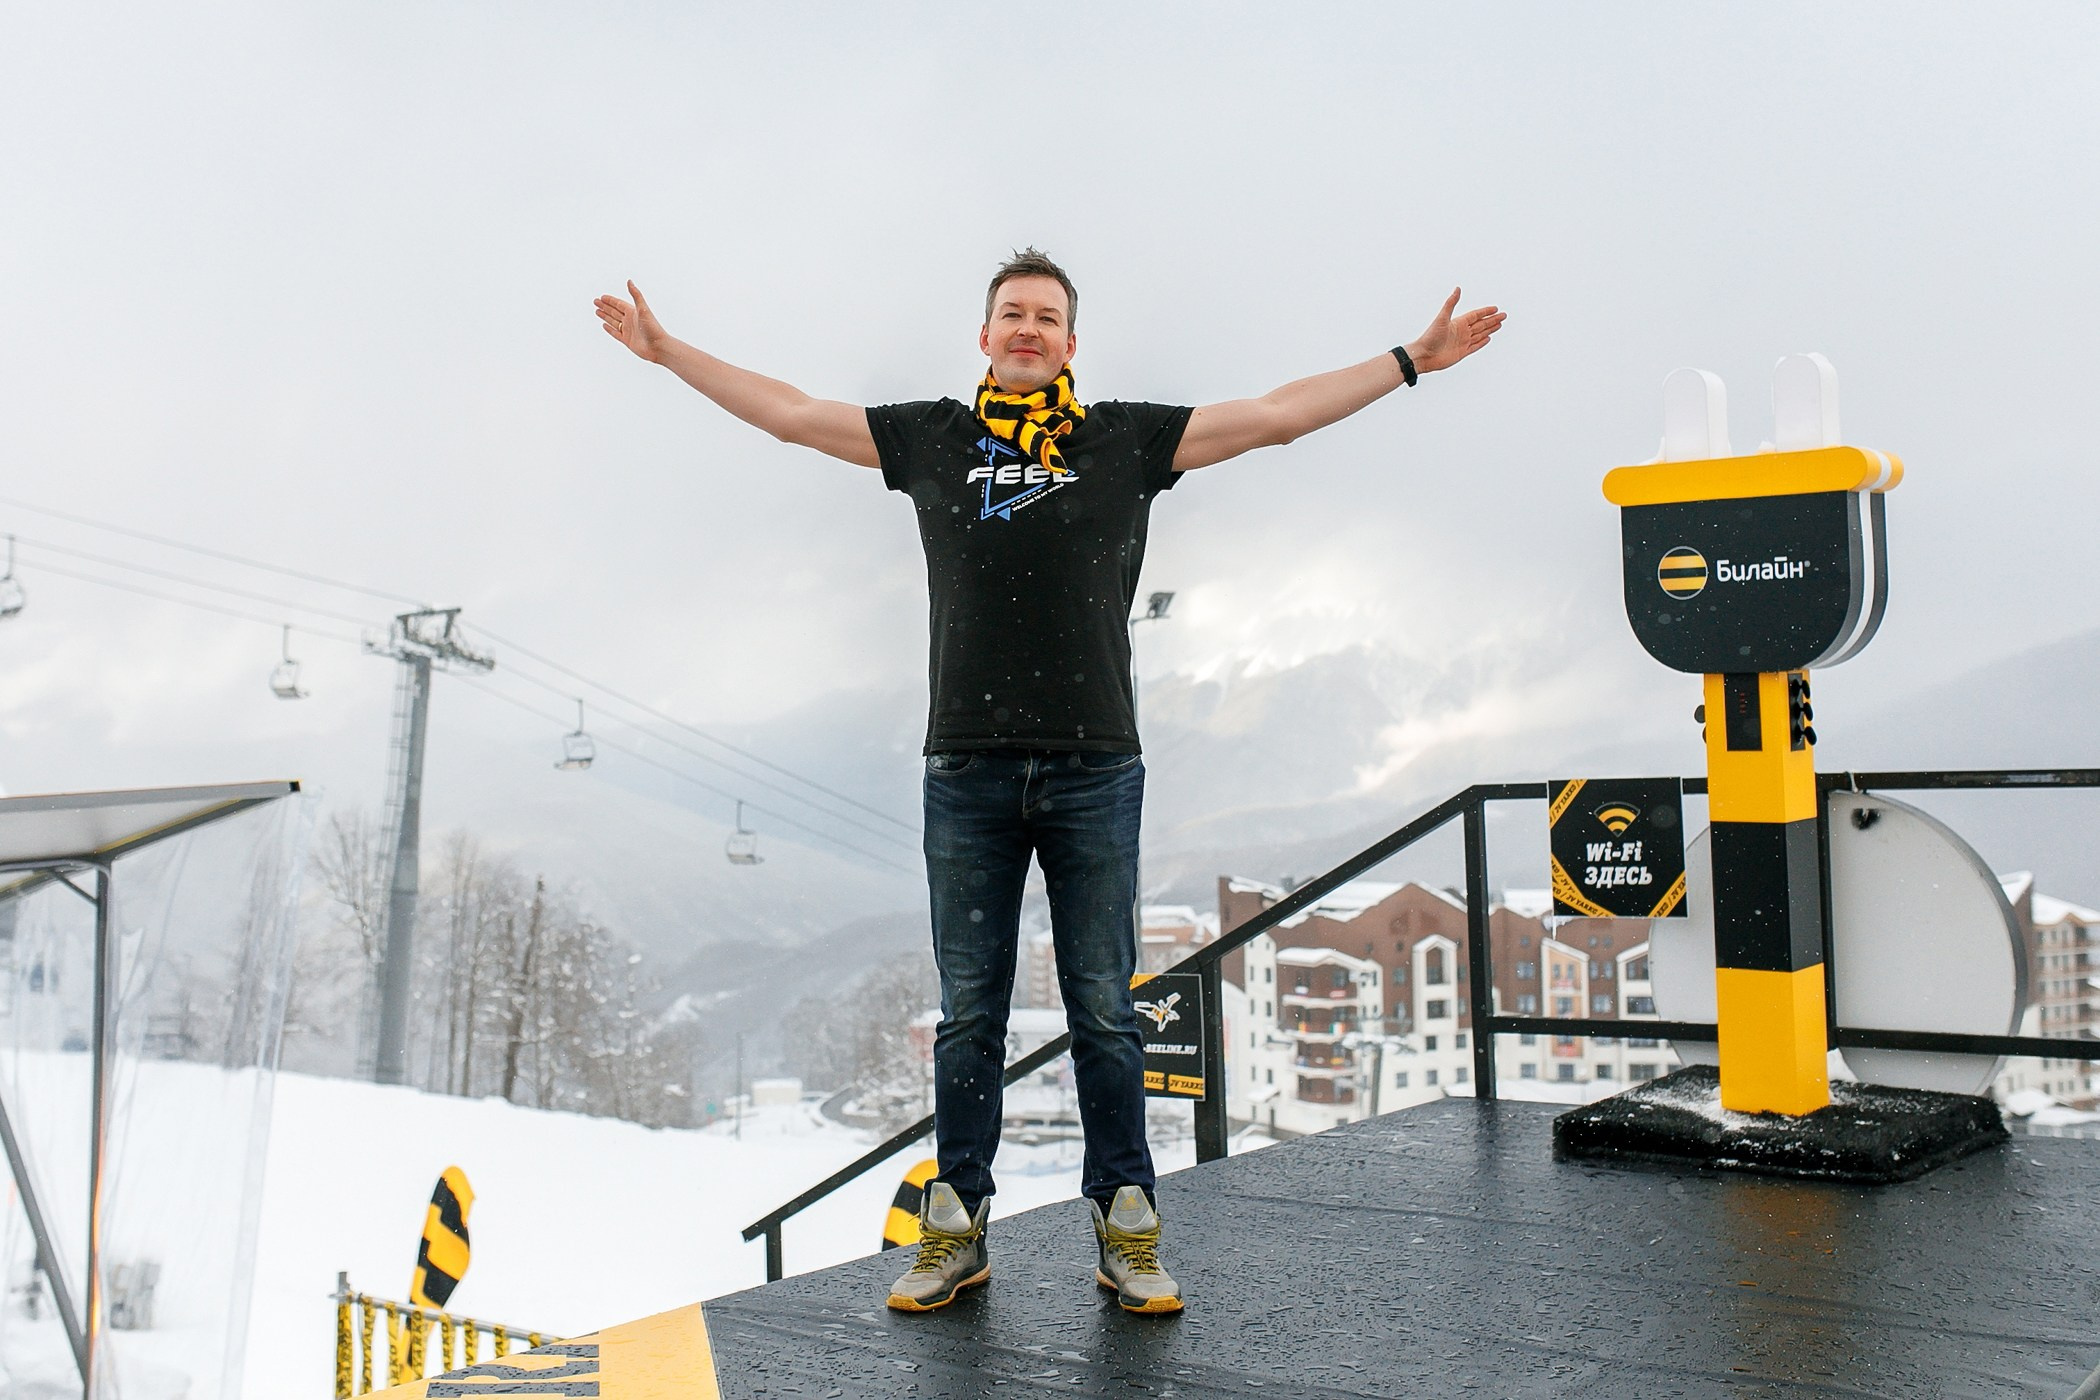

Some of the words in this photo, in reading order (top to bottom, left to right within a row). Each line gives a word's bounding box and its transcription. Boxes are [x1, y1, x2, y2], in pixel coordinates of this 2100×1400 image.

[966, 463, 1080, 485] FEEL
[1012, 498, 1035, 511] WELCOME
[1040, 490, 1048, 498] MY
[1047, 483, 1065, 493] WORLD
[1716, 556, 1804, 582] Билайн
[1586, 841, 1643, 862] Wi-Fi
[1584, 866, 1653, 889] ЗДЕСЬ
[441, 1322, 451, 1371] ARKO
